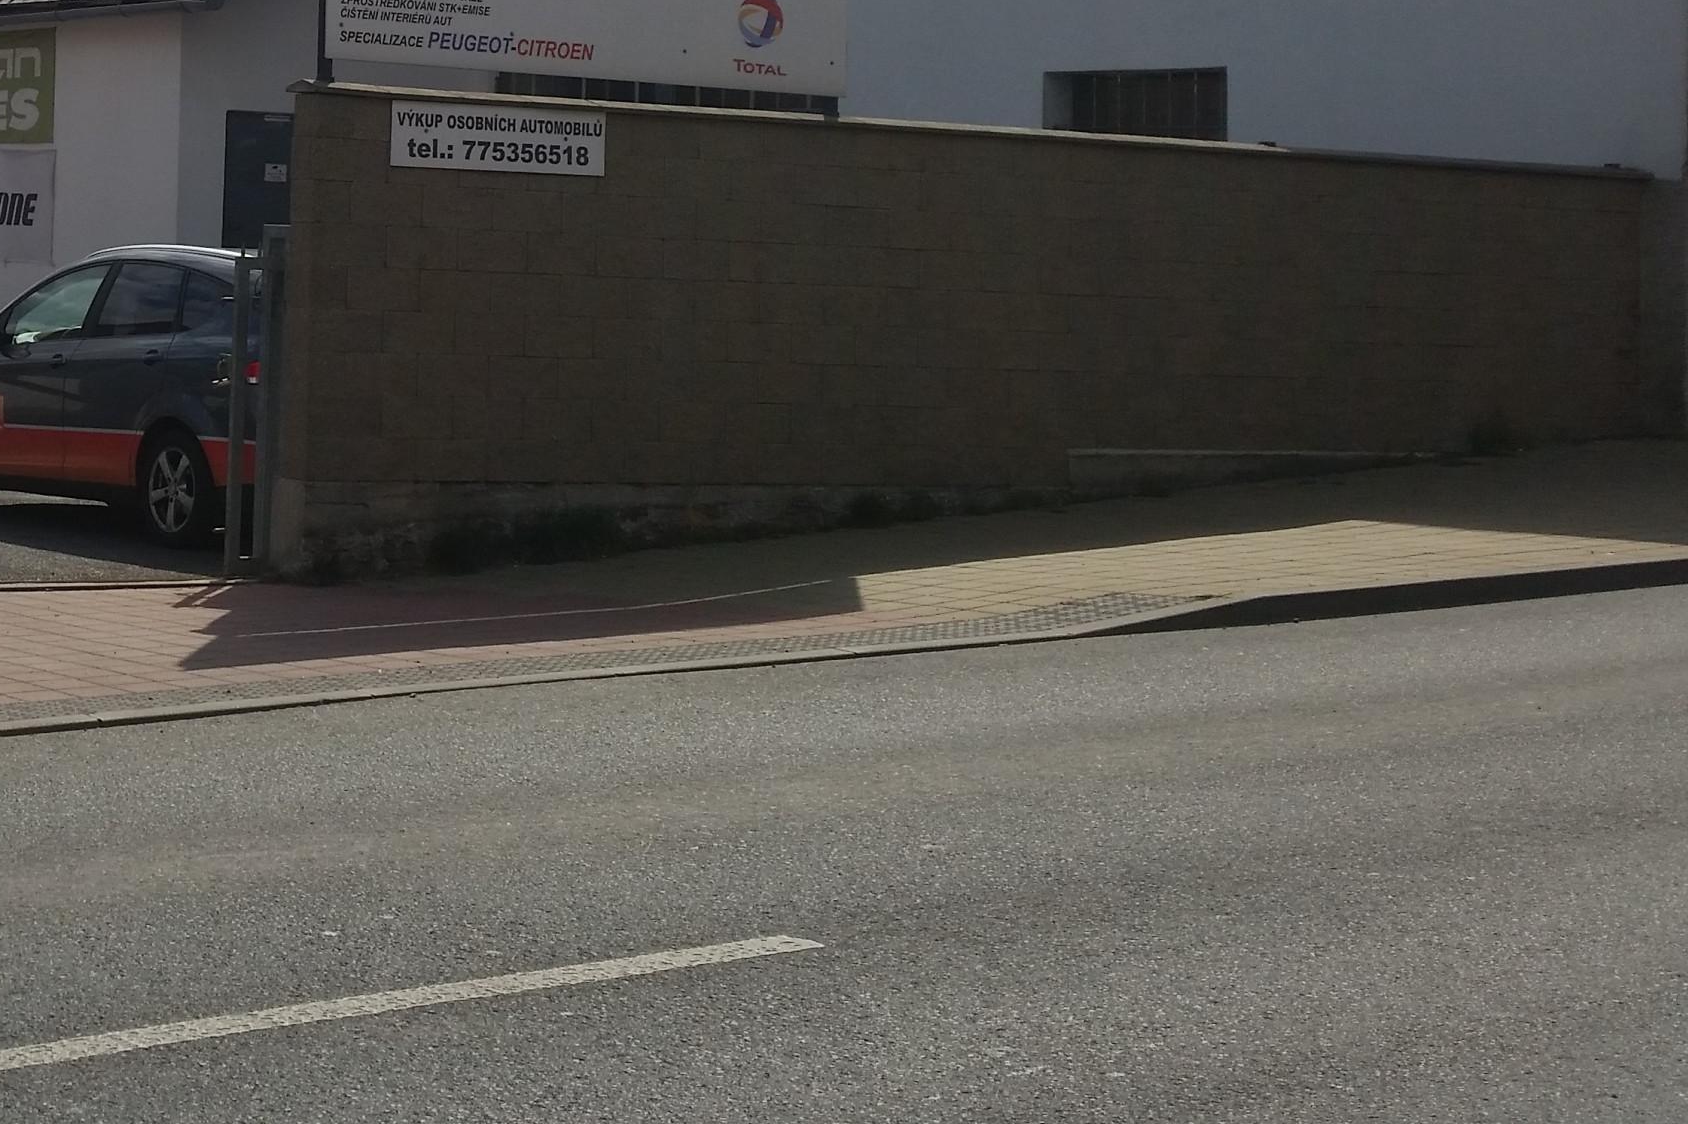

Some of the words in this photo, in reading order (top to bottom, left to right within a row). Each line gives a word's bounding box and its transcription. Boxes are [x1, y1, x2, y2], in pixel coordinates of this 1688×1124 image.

[438, 2, 491, 16] STK+EMISE
[433, 16, 453, 26] AUT
[339, 30, 424, 47] SPECIALIZACE
[733, 58, 787, 76] TOTAL
[397, 109, 443, 128] VÝKUP
[447, 114, 516, 133] OSOBNÍCH
[520, 118, 603, 137] AUTOMOBILŮ
[407, 138, 454, 159] tel.:
[462, 140, 589, 166] 775356518
